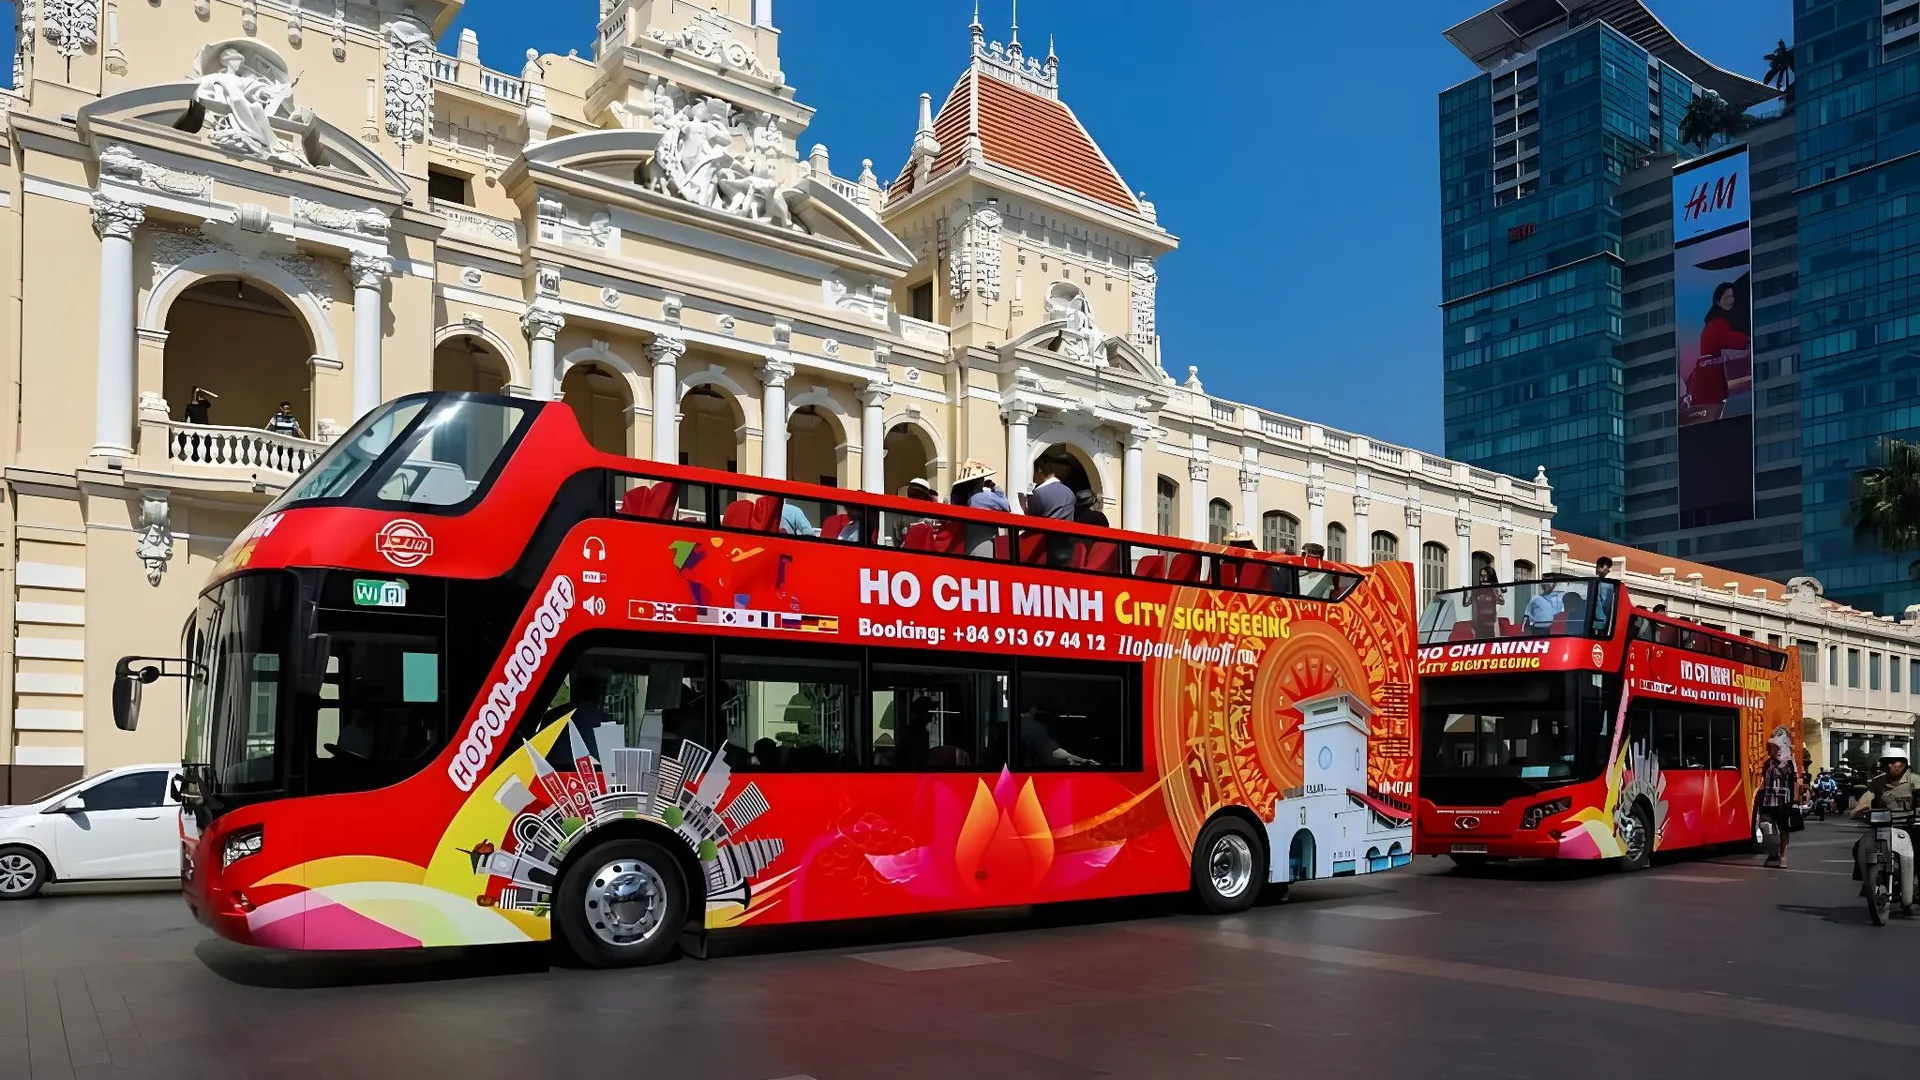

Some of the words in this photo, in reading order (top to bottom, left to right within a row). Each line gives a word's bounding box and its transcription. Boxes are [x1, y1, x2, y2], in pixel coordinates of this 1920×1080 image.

[1683, 172, 1737, 221] H&M
[859, 568, 921, 608] HO
[932, 574, 1001, 614] CHI
[1012, 582, 1104, 622] MINH
[858, 618, 945, 645] Booking:
[953, 625, 989, 644] +84
[994, 628, 1028, 646] 913
[1033, 630, 1055, 647] 67
[1060, 631, 1081, 649] 44
[1087, 633, 1106, 651] 12
[1448, 643, 1484, 657] CHI
[1490, 640, 1550, 655] MINH
[453, 578, 573, 788] HOPON-HOPOFF
